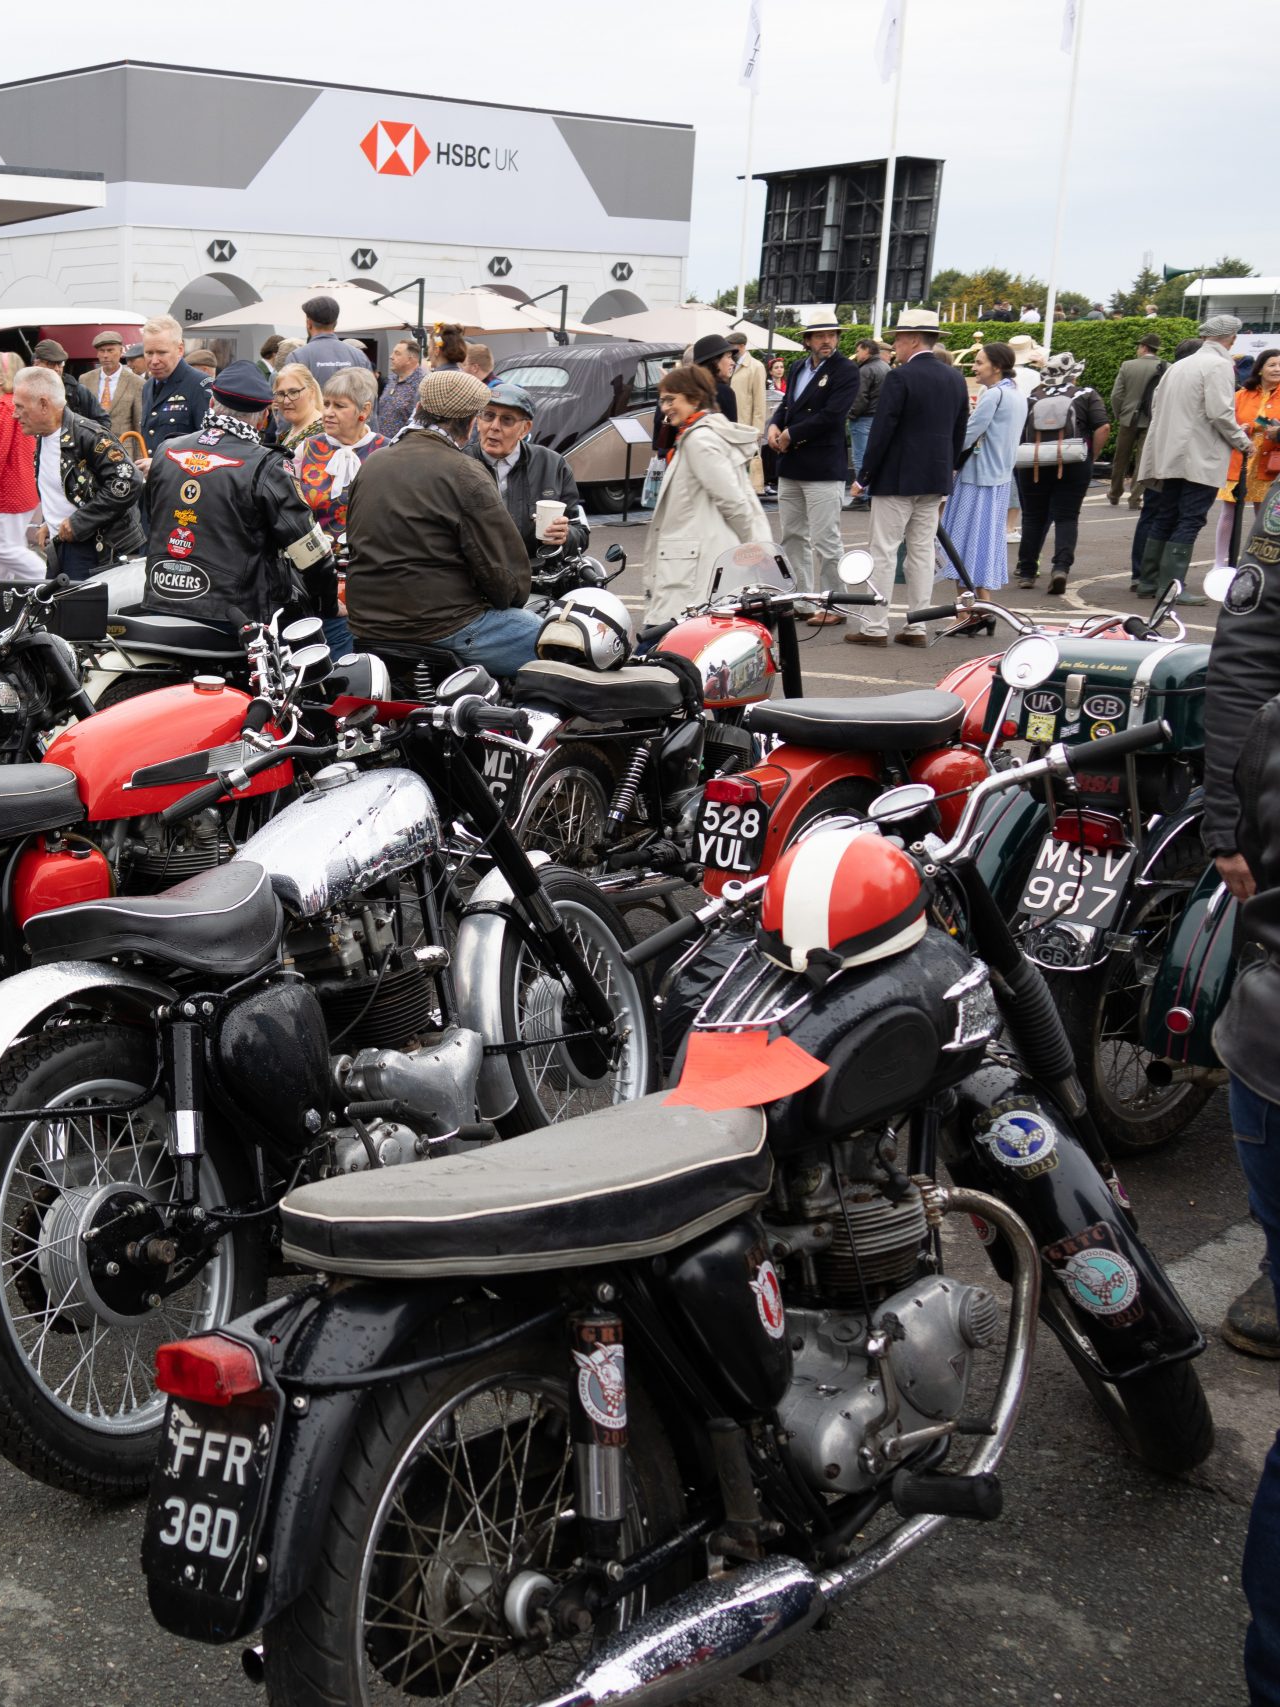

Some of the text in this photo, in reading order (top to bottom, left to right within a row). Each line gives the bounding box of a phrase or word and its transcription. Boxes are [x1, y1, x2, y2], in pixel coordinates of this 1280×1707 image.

[436, 141, 519, 172] HSBC UK
[185, 308, 204, 321] Bar
[169, 537, 193, 549] MOTUL
[153, 571, 201, 589] ROCKERS
[1031, 694, 1056, 711] UK
[1090, 699, 1118, 715] GB
[702, 801, 760, 839] 528
[698, 833, 751, 871] YUL
[1036, 838, 1130, 882] MSV
[1023, 876, 1117, 920] 987
[1038, 948, 1066, 965] GB
[1023, 1158, 1054, 1177] 2023
[173, 1426, 252, 1486] FFR
[159, 1498, 239, 1559] 38D
